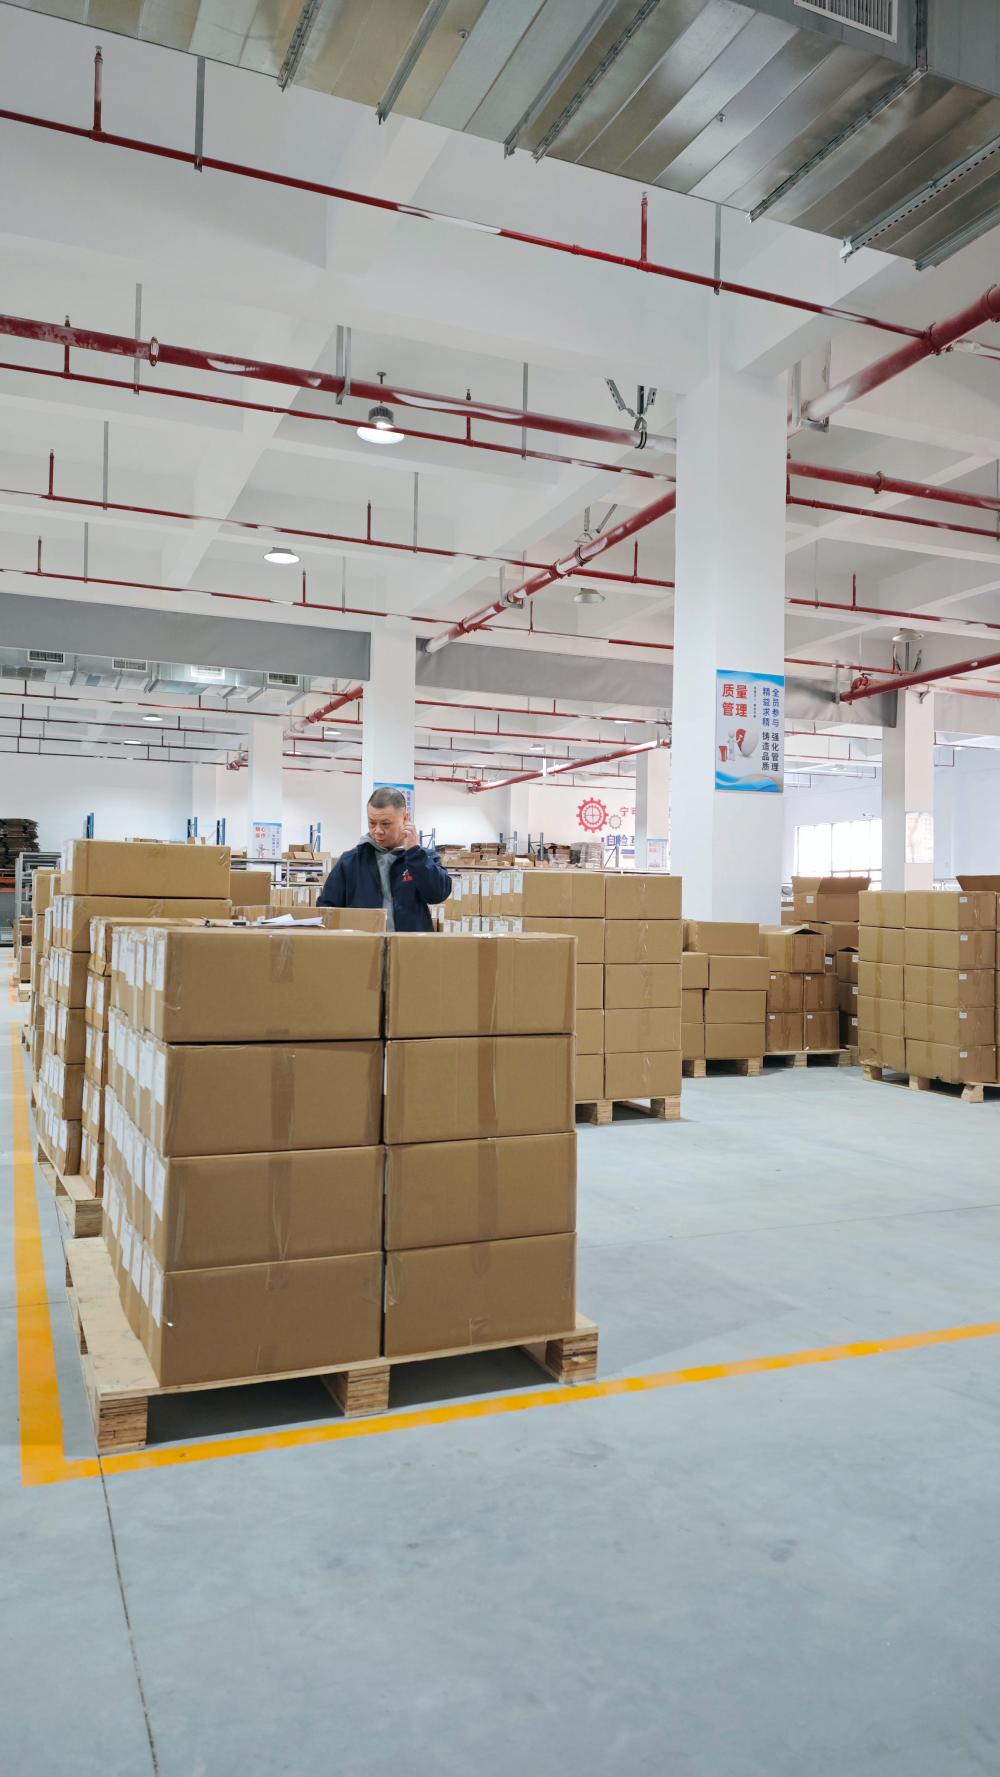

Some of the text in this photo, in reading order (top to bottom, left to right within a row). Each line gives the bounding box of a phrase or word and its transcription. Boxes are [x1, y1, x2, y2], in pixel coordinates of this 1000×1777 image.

[722, 684, 748, 699] 质量
[722, 702, 748, 717] 管理
[762, 687, 770, 771] 精益求精 铸造品质
[771, 733, 779, 772] 强化管理
